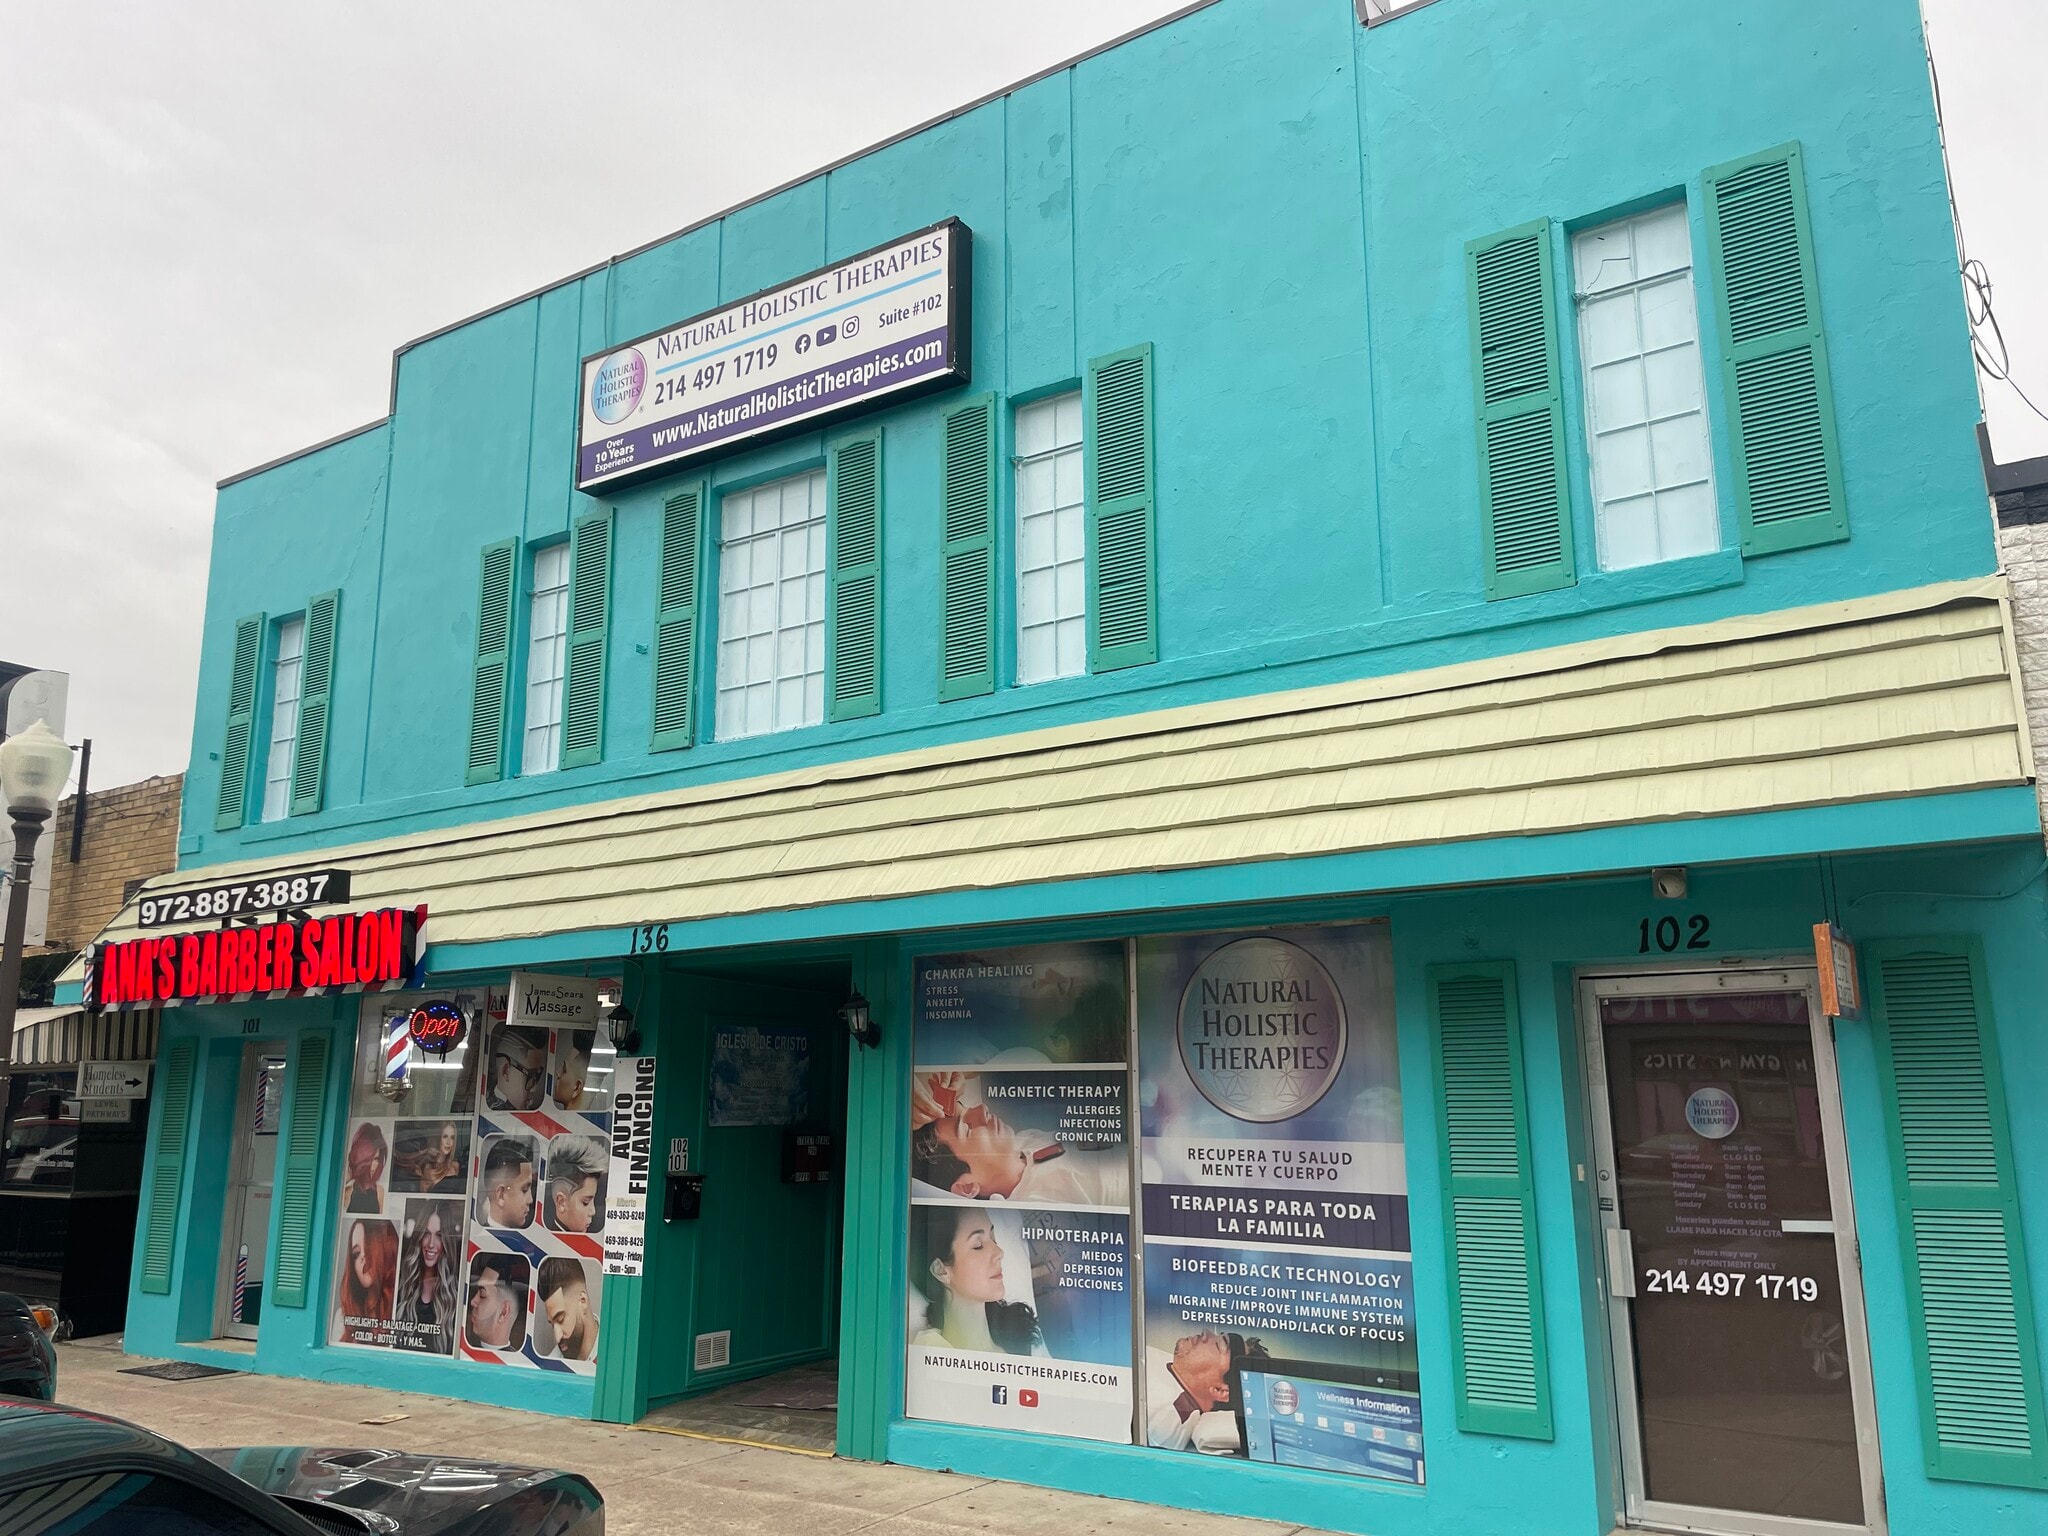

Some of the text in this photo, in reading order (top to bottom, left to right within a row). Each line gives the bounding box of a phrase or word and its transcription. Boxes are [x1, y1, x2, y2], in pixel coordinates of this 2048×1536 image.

[657, 236, 943, 359] NATURAL HOLISTIC THERAPIES
[879, 293, 942, 328] Suite #102
[601, 360, 640, 383] NATURAL
[655, 343, 778, 405] 214 497 1719
[600, 373, 639, 396] HOLISTIC
[652, 338, 943, 449] www.NaturalHolisticTherapies.com
[596, 386, 641, 410] THERAPIES
[606, 437, 625, 449] Over
[595, 443, 635, 464] 10 Years
[594, 454, 634, 473] Experience
[630, 924, 669, 955] 136
[1639, 914, 1711, 953] 102
[101, 909, 403, 1004] ANA'S BARBER SALON
[925, 964, 1033, 981] CHAKRA HEALING
[525, 984, 555, 997] James
[555, 986, 584, 999] Sears
[926, 985, 958, 996] STRESS
[1201, 977, 1318, 1006] NATURAL
[525, 995, 582, 1016] Massage
[926, 998, 965, 1008] ANXIETY
[926, 1010, 972, 1020] INSOMNIA
[1202, 1009, 1318, 1037] HOLISTIC
[241, 1017, 261, 1034] 101
[411, 1010, 460, 1039] Open
[717, 1033, 808, 1052] IGLESIA DE CRISTO
[1193, 1042, 1329, 1071] THERAPIES
[85, 1065, 127, 1081] Homeless
[83, 1080, 124, 1095] Students
[987, 1085, 1121, 1098] MAGNETIC THERAPY
[1066, 1105, 1121, 1115] ALLERGIES
[1692, 1098, 1730, 1107] NATURAL
[1693, 1107, 1730, 1116] HOLISTIC
[611, 1093, 634, 1160] AUTO
[628, 1058, 655, 1194] FINANCING
[1059, 1118, 1121, 1129] INFECTIONS
[672, 1138, 688, 1153] 102
[1055, 1131, 1122, 1142] CRONIC PAIN
[669, 1154, 688, 1171] 101
[1187, 1147, 1353, 1166] RECUPERA TU SALUD
[1201, 1164, 1338, 1181] MENTE Y CUERPO
[1170, 1195, 1376, 1221] TERAPIAS PARA TODA
[1727, 1202, 1767, 1210] CLOSED
[606, 1210, 645, 1221] 469-363-6248
[1022, 1227, 1125, 1245] HIPNOTERAPIA
[1217, 1217, 1325, 1239] LA FAMILIA
[1666, 1226, 1783, 1238] LLAME PARA HACER SU CITA
[605, 1235, 644, 1247] 469-386-8429
[604, 1249, 643, 1263] Monday Friday
[1081, 1250, 1124, 1263] MIEDOS
[1693, 1248, 1719, 1257] Hours
[609, 1263, 637, 1275] 9am 5pm
[1063, 1263, 1124, 1278] DEPRESION
[1677, 1258, 1777, 1270] BY APPOINTMENT ONLY
[1172, 1258, 1402, 1289] BIOFEEDBACK TECHNOLOGY
[1058, 1276, 1124, 1292] ADICCIONES
[1645, 1268, 1819, 1302] 214 497 1719
[1210, 1282, 1404, 1310] REDUCE JOINT INFLAMMATION
[1169, 1294, 1404, 1326] MIGRAINE /IMPROVE IMMUNE SYSTEM
[344, 1315, 441, 1335] HIGHLIGHTS BALATAGE CORTES
[1181, 1310, 1405, 1343] DEPRESSION/ADHD/LACK OF FOCUS
[354, 1331, 373, 1342] COLOR
[377, 1333, 397, 1345] BOTOX
[403, 1335, 409, 1346] Y
[924, 1354, 1119, 1387] NATURALHOLISTICTHERAPIES.COM
[1316, 1391, 1355, 1406] Wellness
[1356, 1397, 1411, 1415] Information
